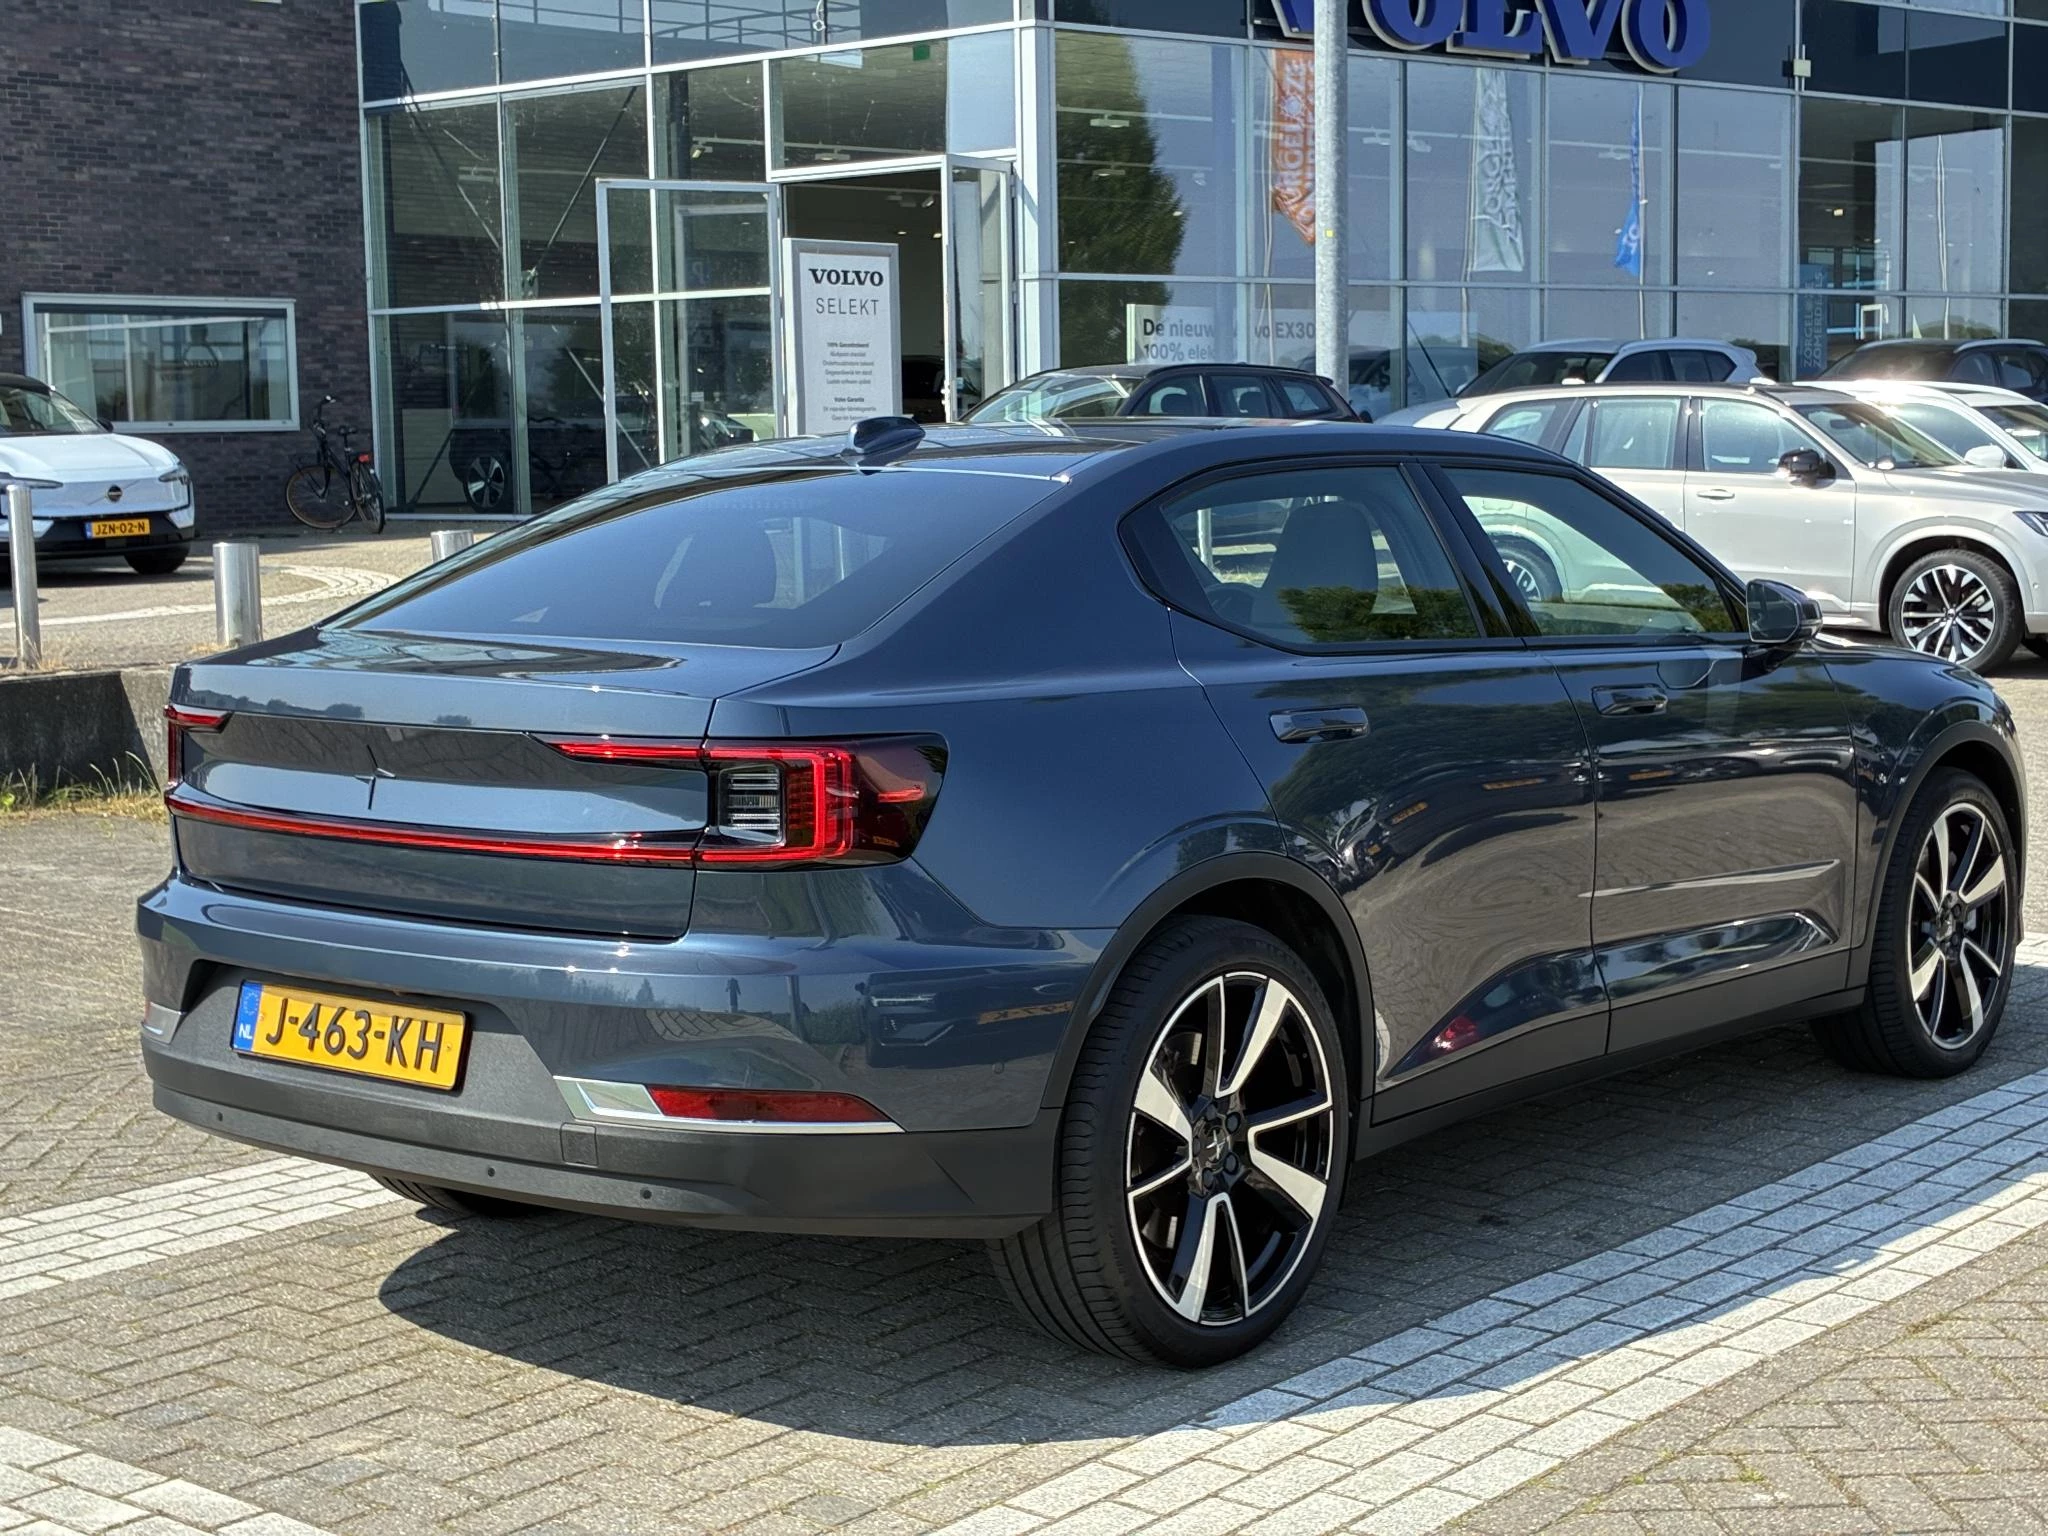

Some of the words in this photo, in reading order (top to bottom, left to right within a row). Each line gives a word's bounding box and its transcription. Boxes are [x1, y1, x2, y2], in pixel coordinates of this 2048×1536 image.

[1272, 0, 1712, 73] OLVO
[808, 268, 884, 287] VOLVO
[816, 297, 880, 316] SELEKT
[1143, 318, 1165, 337] De
[1276, 321, 1316, 339] EX30
[1143, 342, 1185, 362] 100%
[95, 521, 146, 536] JZN-02-N
[238, 1023, 253, 1040] NL
[265, 997, 445, 1074] J-463-KH
